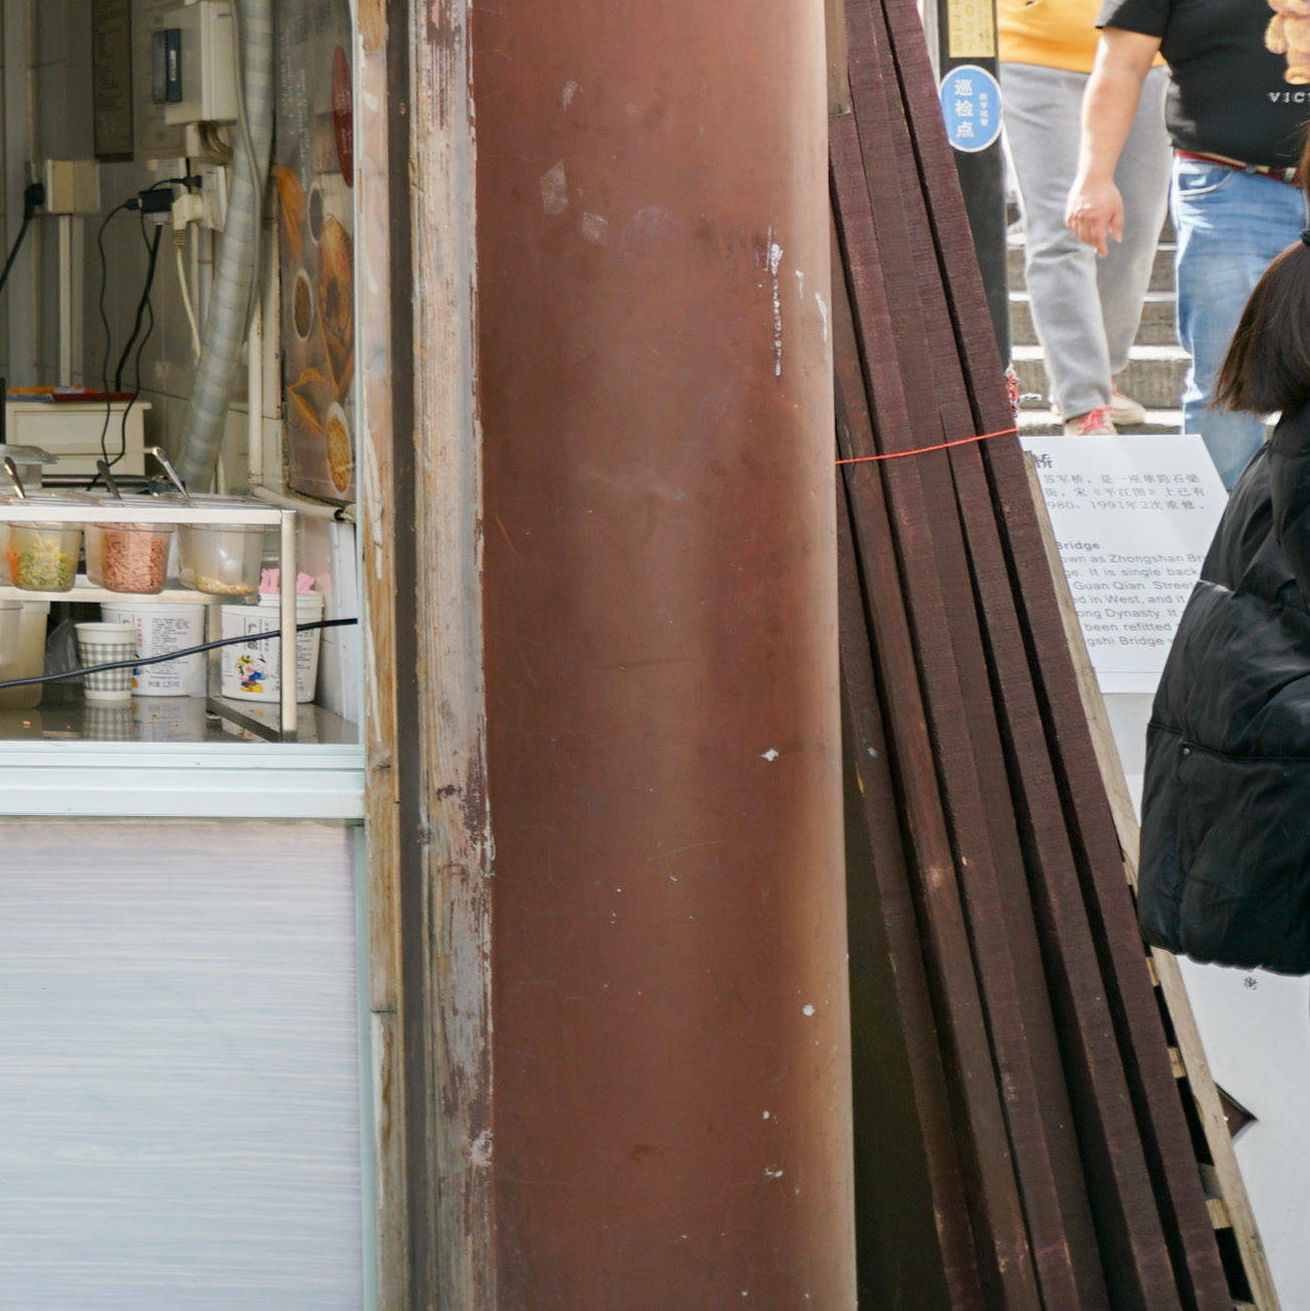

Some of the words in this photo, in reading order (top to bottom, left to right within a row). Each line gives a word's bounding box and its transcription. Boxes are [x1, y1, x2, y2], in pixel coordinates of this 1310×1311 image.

[954, 79, 974, 138] 巡检点
[1110, 554, 1185, 565] Zhongshan
[1121, 567, 1163, 578] single
[1074, 582, 1108, 590] Guan
[1113, 582, 1145, 591] Qian
[1091, 596, 1103, 604] in
[1148, 596, 1173, 604] and
[1085, 623, 1119, 631] been
[1123, 623, 1172, 631] refitted
[1120, 637, 1165, 648] Bridge
